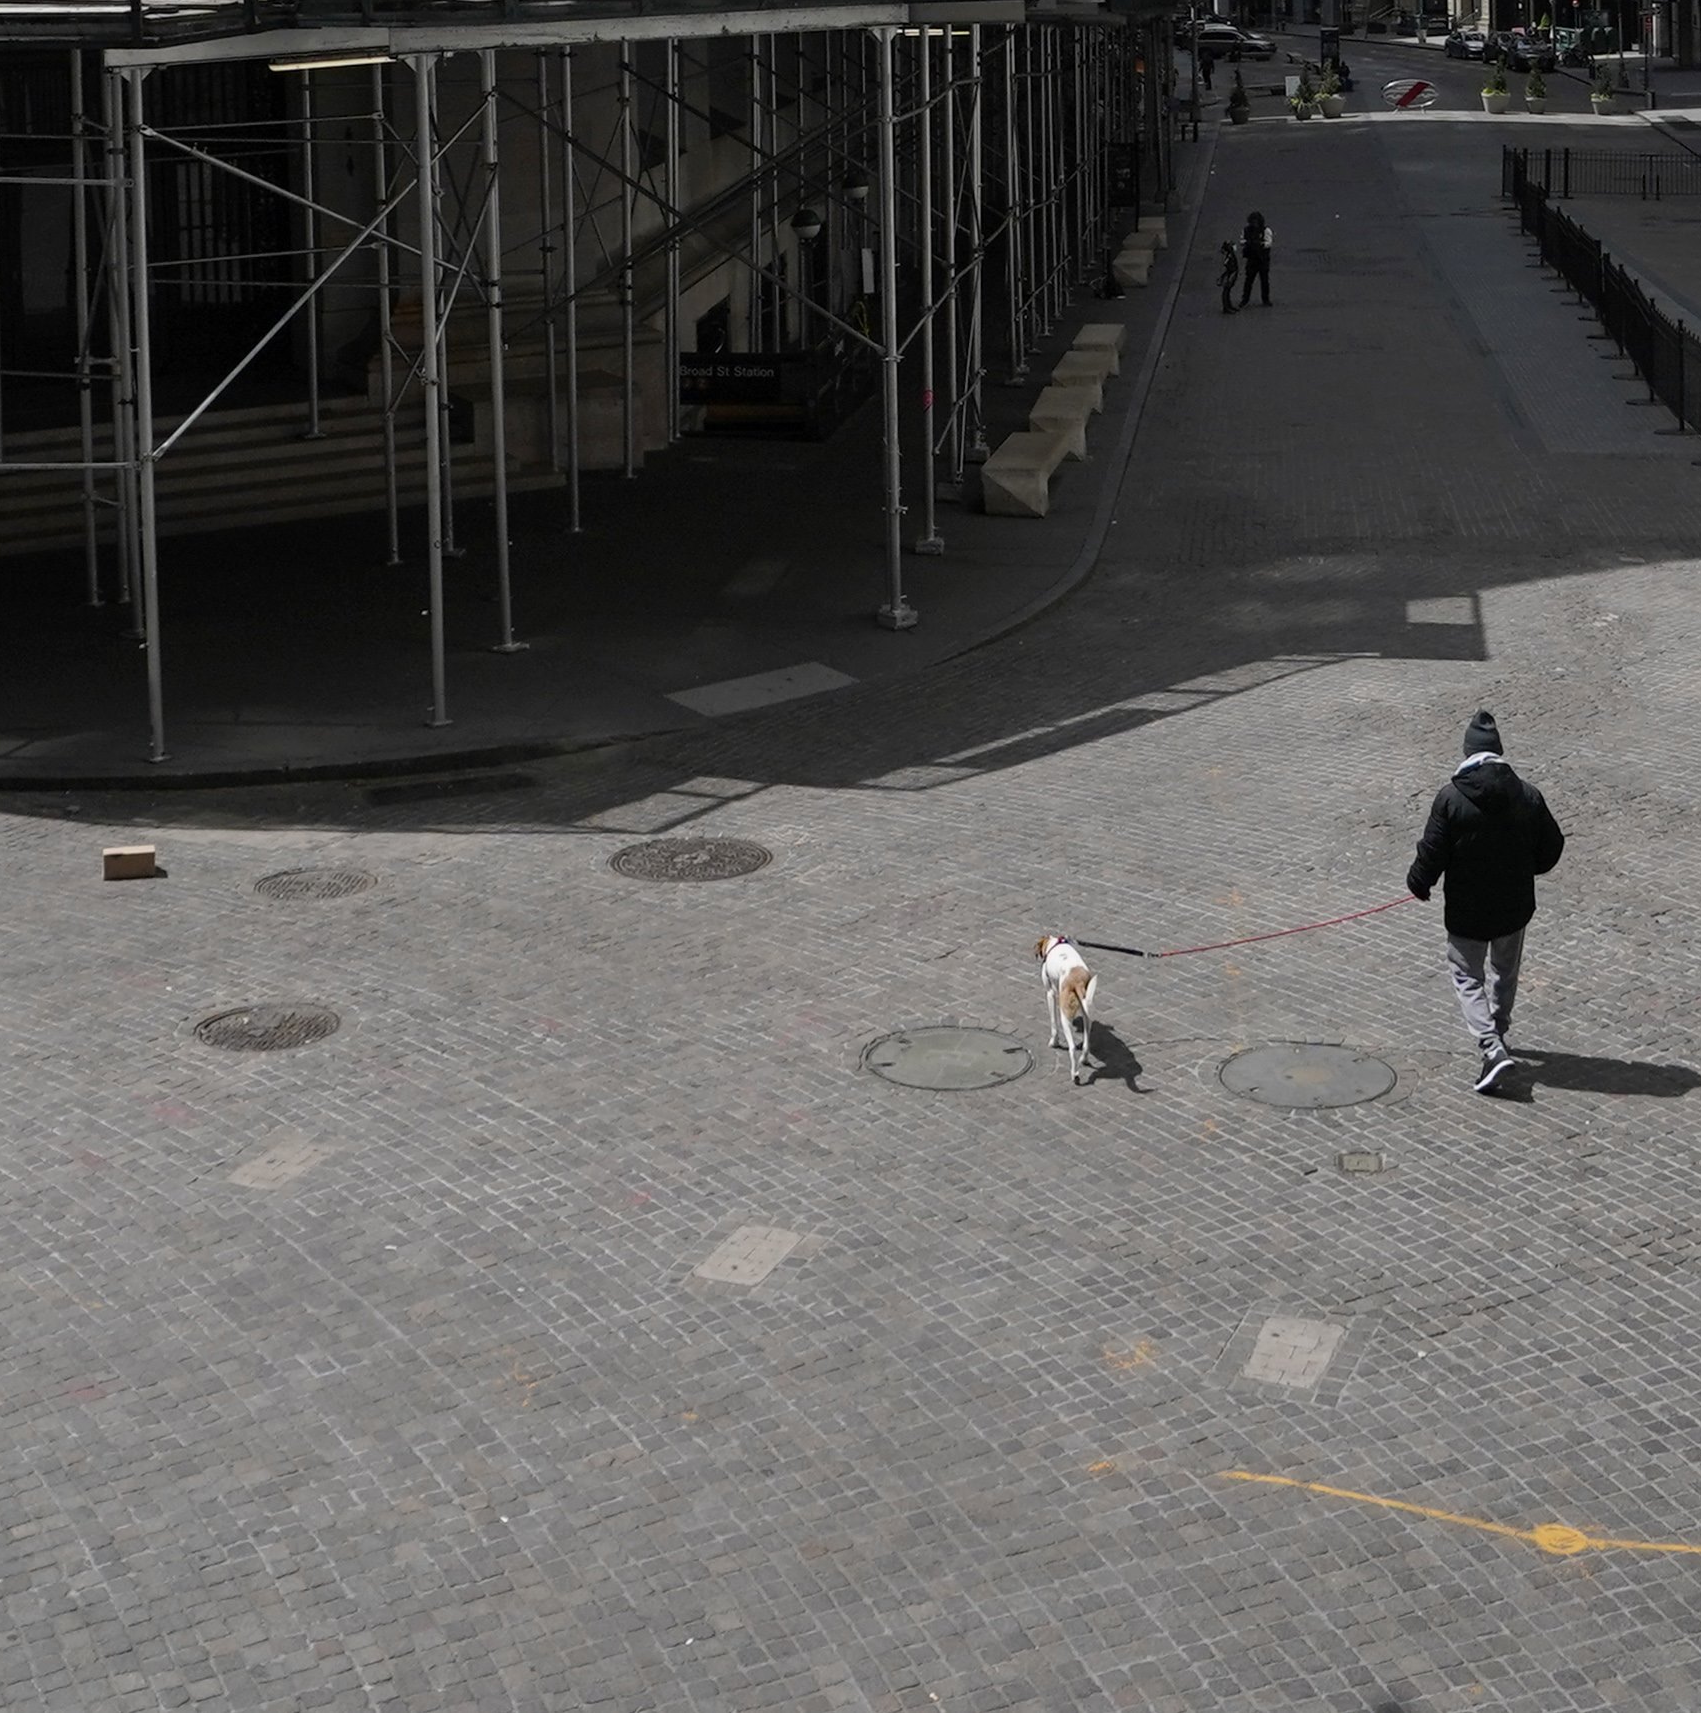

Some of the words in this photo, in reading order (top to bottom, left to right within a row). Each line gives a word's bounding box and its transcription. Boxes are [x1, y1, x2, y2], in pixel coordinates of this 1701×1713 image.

[678, 365, 713, 377] Broad
[716, 365, 731, 377] St
[733, 365, 775, 377] Station
